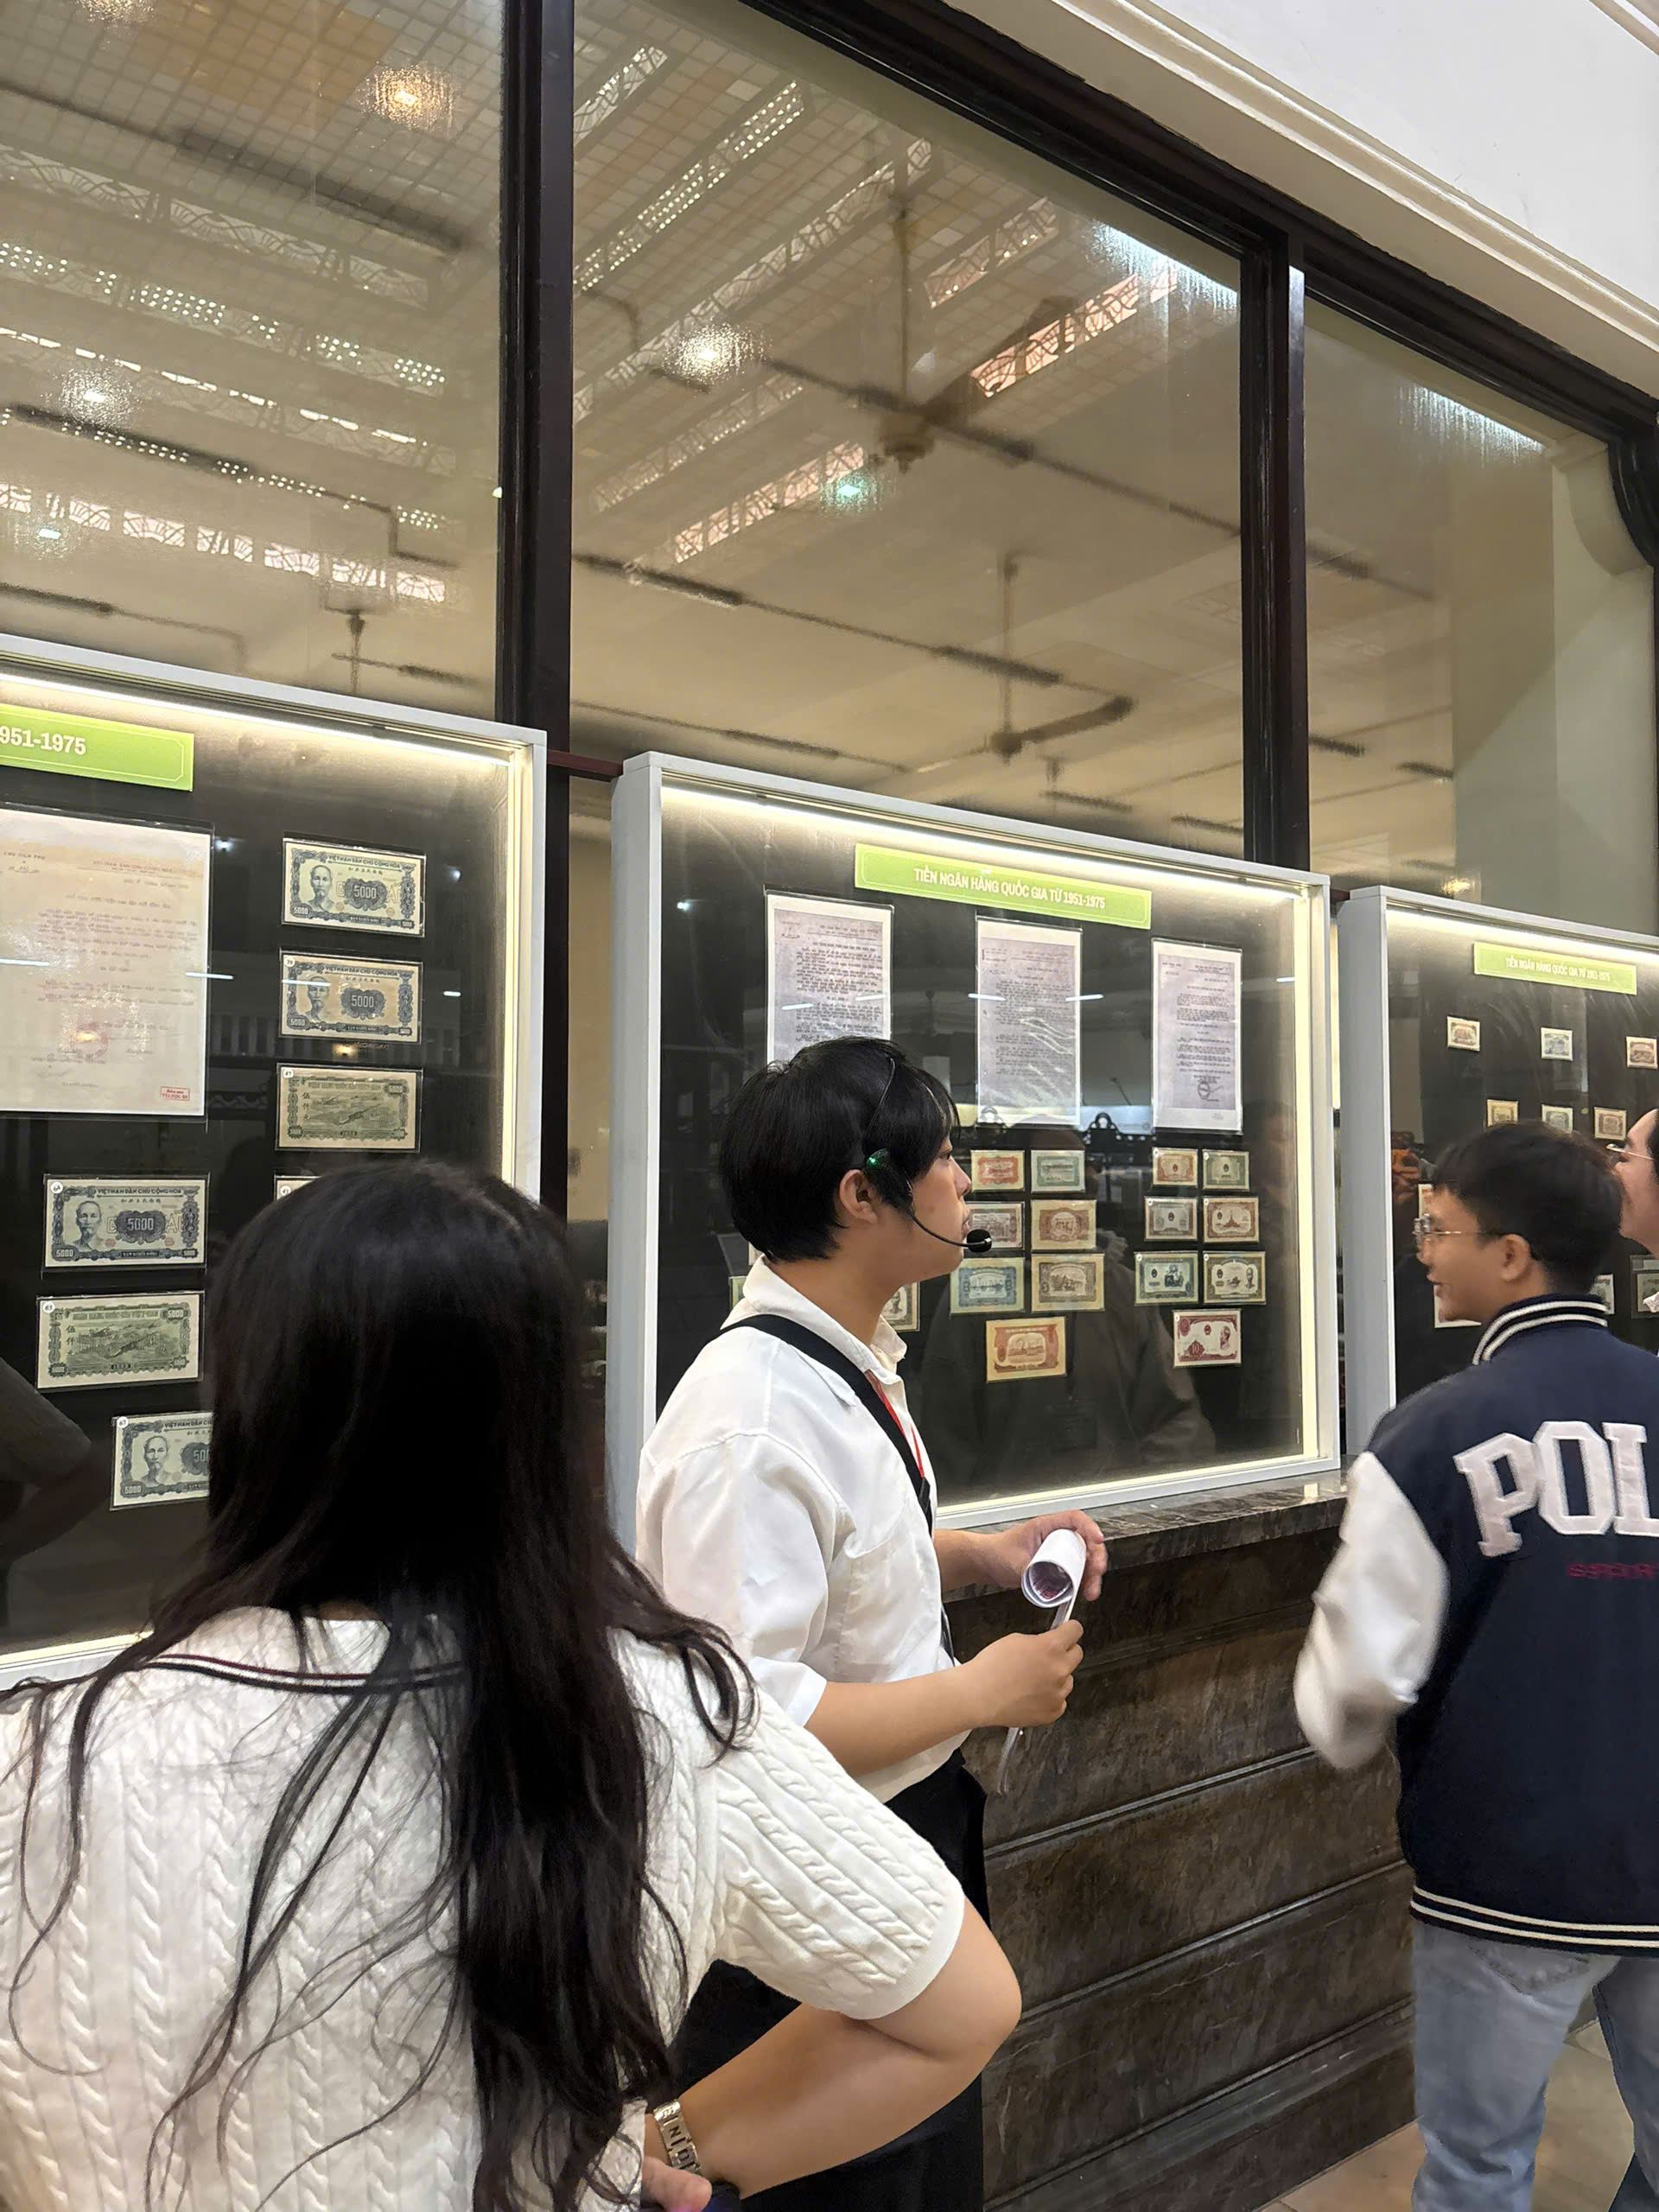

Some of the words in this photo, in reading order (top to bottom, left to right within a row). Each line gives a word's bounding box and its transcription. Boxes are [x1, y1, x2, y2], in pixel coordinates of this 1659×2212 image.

[353, 885, 377, 899] 5000
[913, 865, 938, 885] TIỀN
[939, 871, 969, 889] NGÂN
[970, 874, 1000, 893] HÀNG
[1001, 879, 1030, 898] QUỐC
[1031, 886, 1048, 901] GIA
[1049, 887, 1063, 902] TỪ
[1063, 892, 1106, 910] 1951-1975
[351, 995, 374, 1008] 5000
[127, 1217, 154, 1231] 5000
[55, 1249, 73, 1257] 5000
[124, 1485, 142, 1495] 5000
